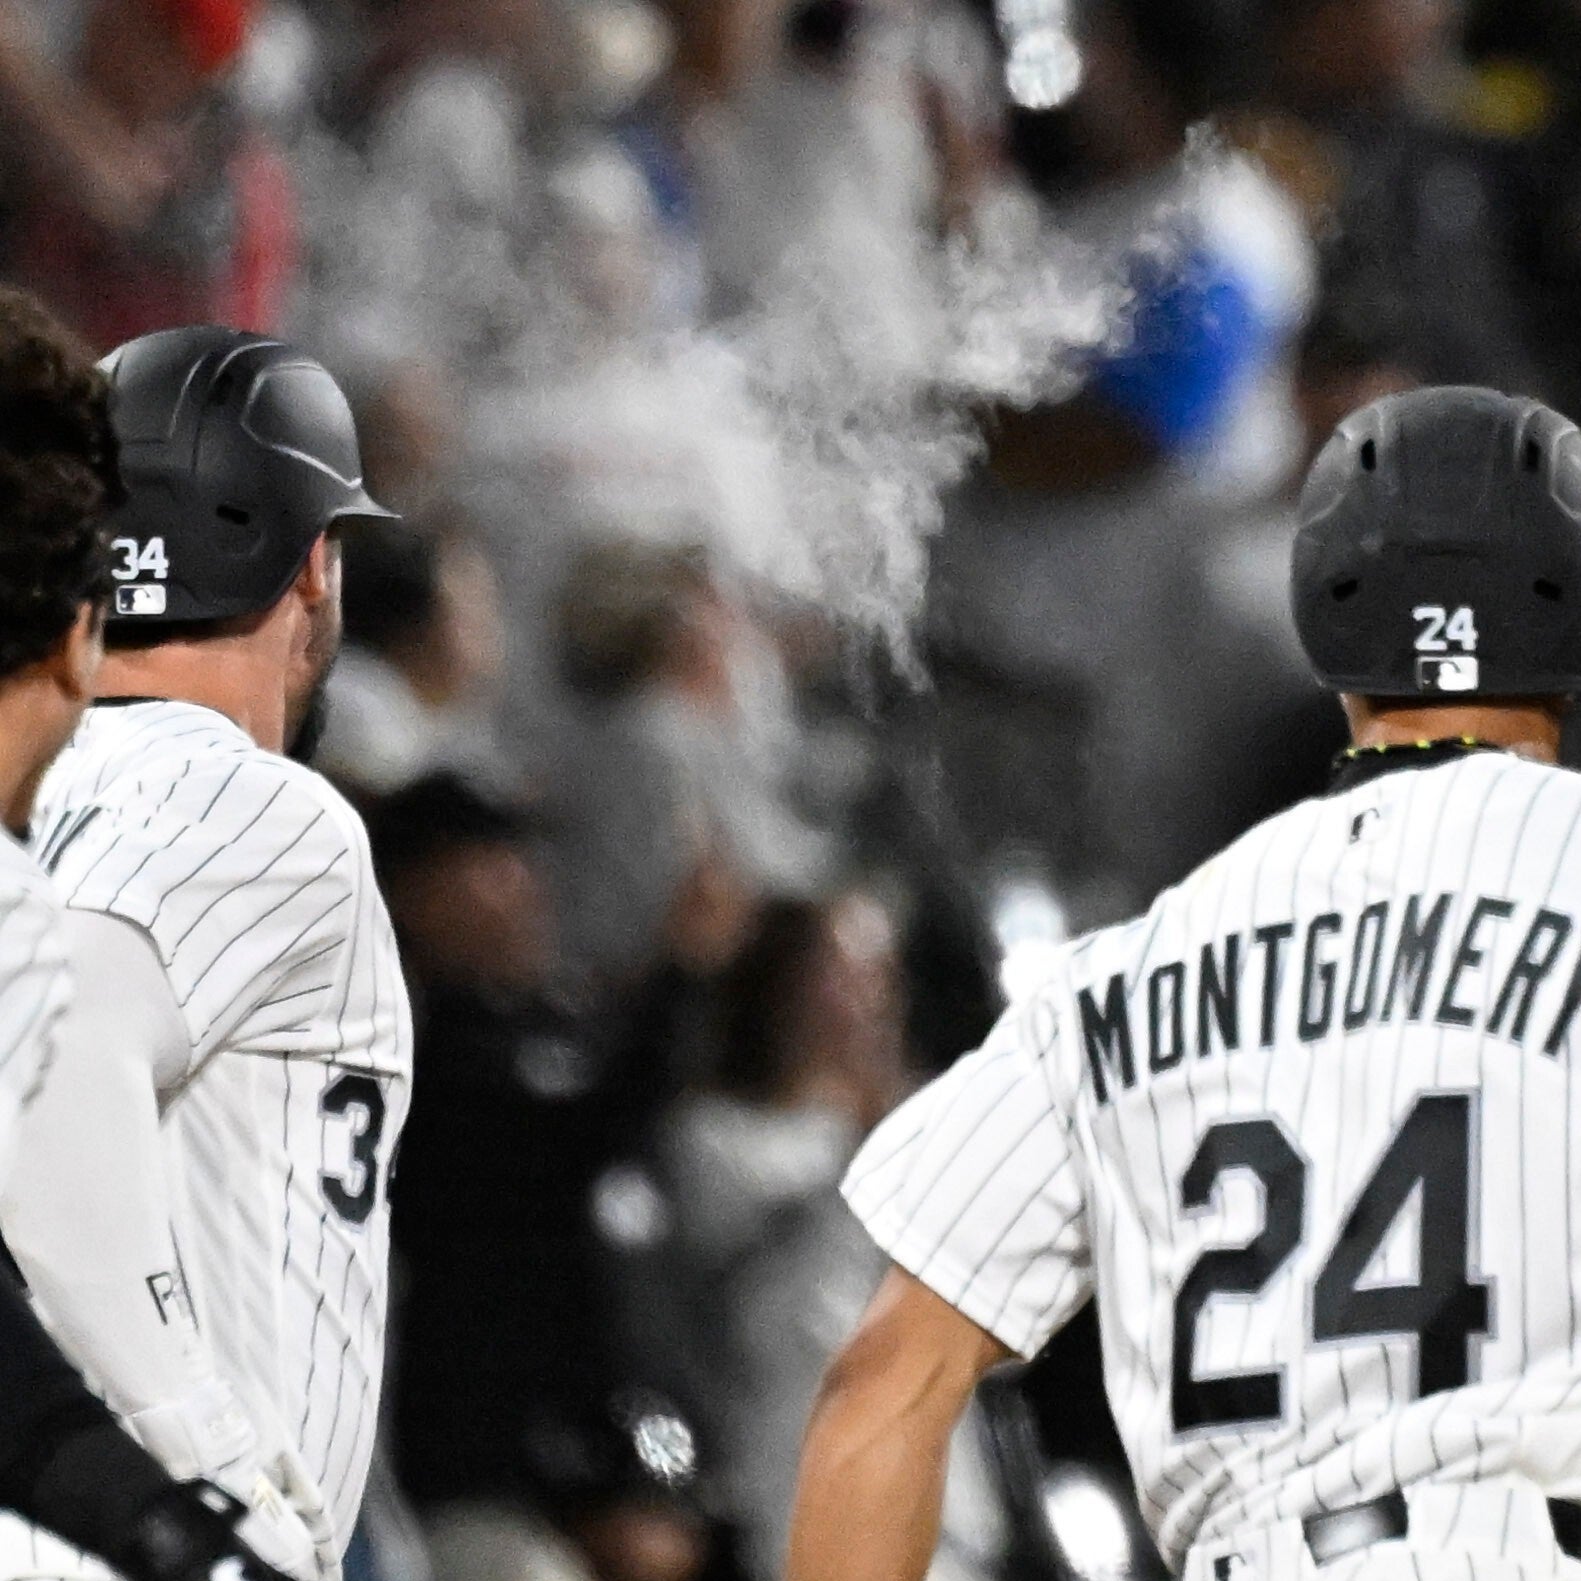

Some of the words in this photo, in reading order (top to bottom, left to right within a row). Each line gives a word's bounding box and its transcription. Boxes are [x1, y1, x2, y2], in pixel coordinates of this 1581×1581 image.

[110, 536, 170, 580] 34
[1411, 603, 1479, 651] 24
[317, 1068, 386, 1232] 3
[1167, 1085, 1497, 1441] 24
